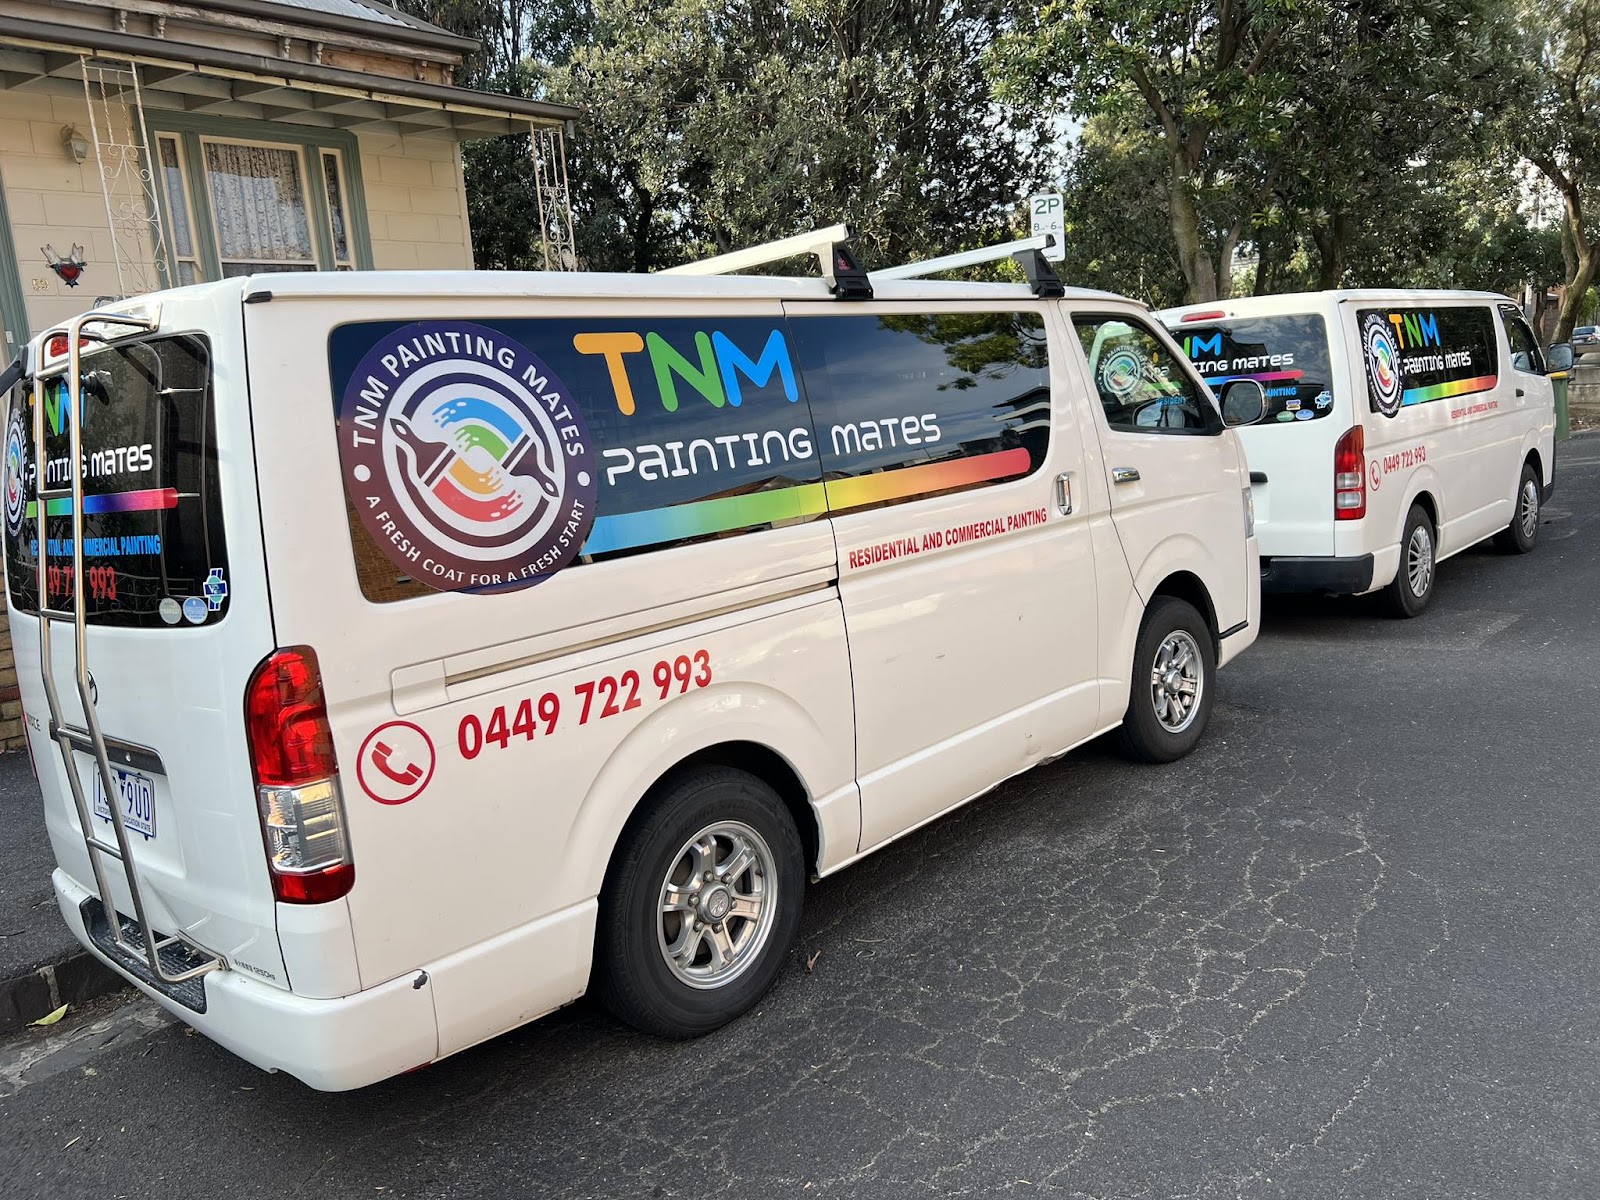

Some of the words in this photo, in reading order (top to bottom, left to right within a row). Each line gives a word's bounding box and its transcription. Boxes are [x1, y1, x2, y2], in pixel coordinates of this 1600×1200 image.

[1034, 198, 1060, 214] 2P
[1388, 314, 1440, 350] TNM
[353, 374, 390, 448] TNM
[380, 331, 516, 378] PAINTING
[521, 364, 585, 458] MATES
[573, 329, 799, 416] TNM
[1384, 454, 1400, 474] 0449
[1402, 450, 1413, 468] 722
[1414, 446, 1426, 464] 993
[120, 534, 161, 556] PAINTING
[366, 494, 381, 509] A
[376, 510, 421, 562] FRESH
[422, 558, 466, 584] COAT
[470, 572, 502, 586] FOR
[507, 572, 518, 582] A
[520, 544, 562, 578] FRESH
[558, 498, 585, 547] START
[849, 538, 920, 569] RESIDENTIAL
[922, 532, 943, 552] AND
[945, 518, 1006, 546] COMMERCIAL
[1007, 508, 1048, 532] PAINTING
[89, 566, 116, 600] 993
[458, 692, 560, 760] 0449
[574, 670, 642, 726] 722
[653, 649, 712, 700] 993
